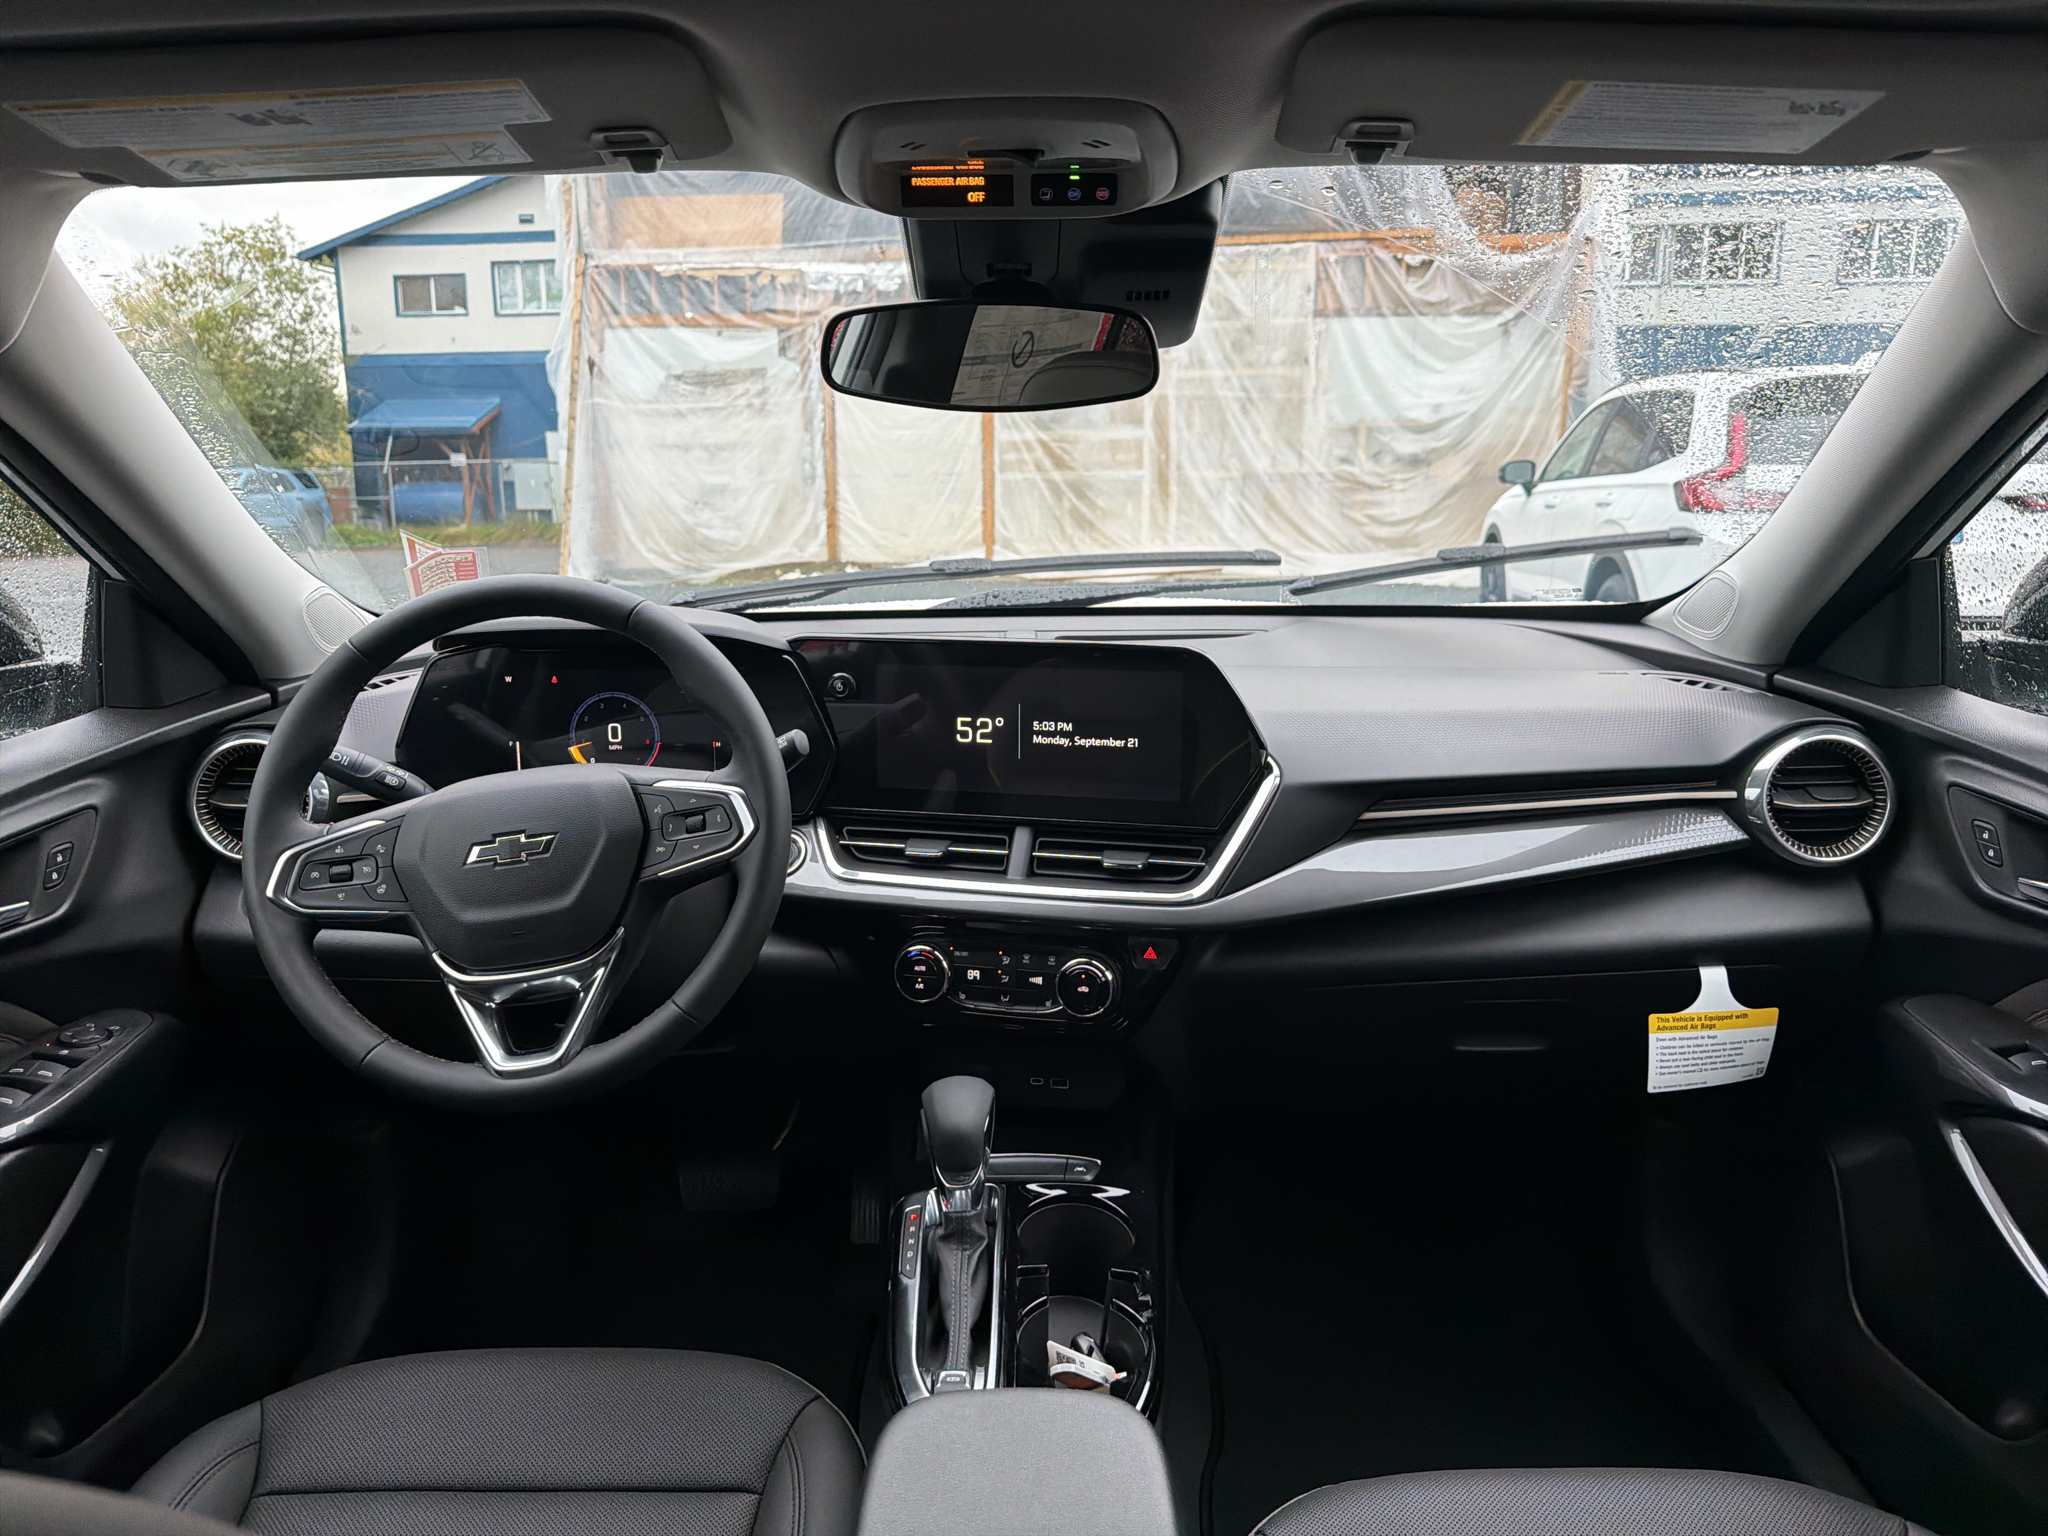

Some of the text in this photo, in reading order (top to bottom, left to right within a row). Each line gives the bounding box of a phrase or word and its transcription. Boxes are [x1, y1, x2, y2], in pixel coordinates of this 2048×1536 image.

[911, 176, 955, 187] PASSENGER
[967, 191, 986, 203] OFF
[504, 675, 513, 683] W
[956, 717, 1004, 743] 52°
[1032, 721, 1073, 732] 5:03 PM
[607, 723, 622, 742] 0
[1032, 734, 1139, 748] Monday, September 21
[967, 969, 980, 981] 89
[1704, 1014, 1733, 1022] Equipped
[1656, 1023, 1688, 1031] Advanced
[1701, 1022, 1716, 1030] Bags
